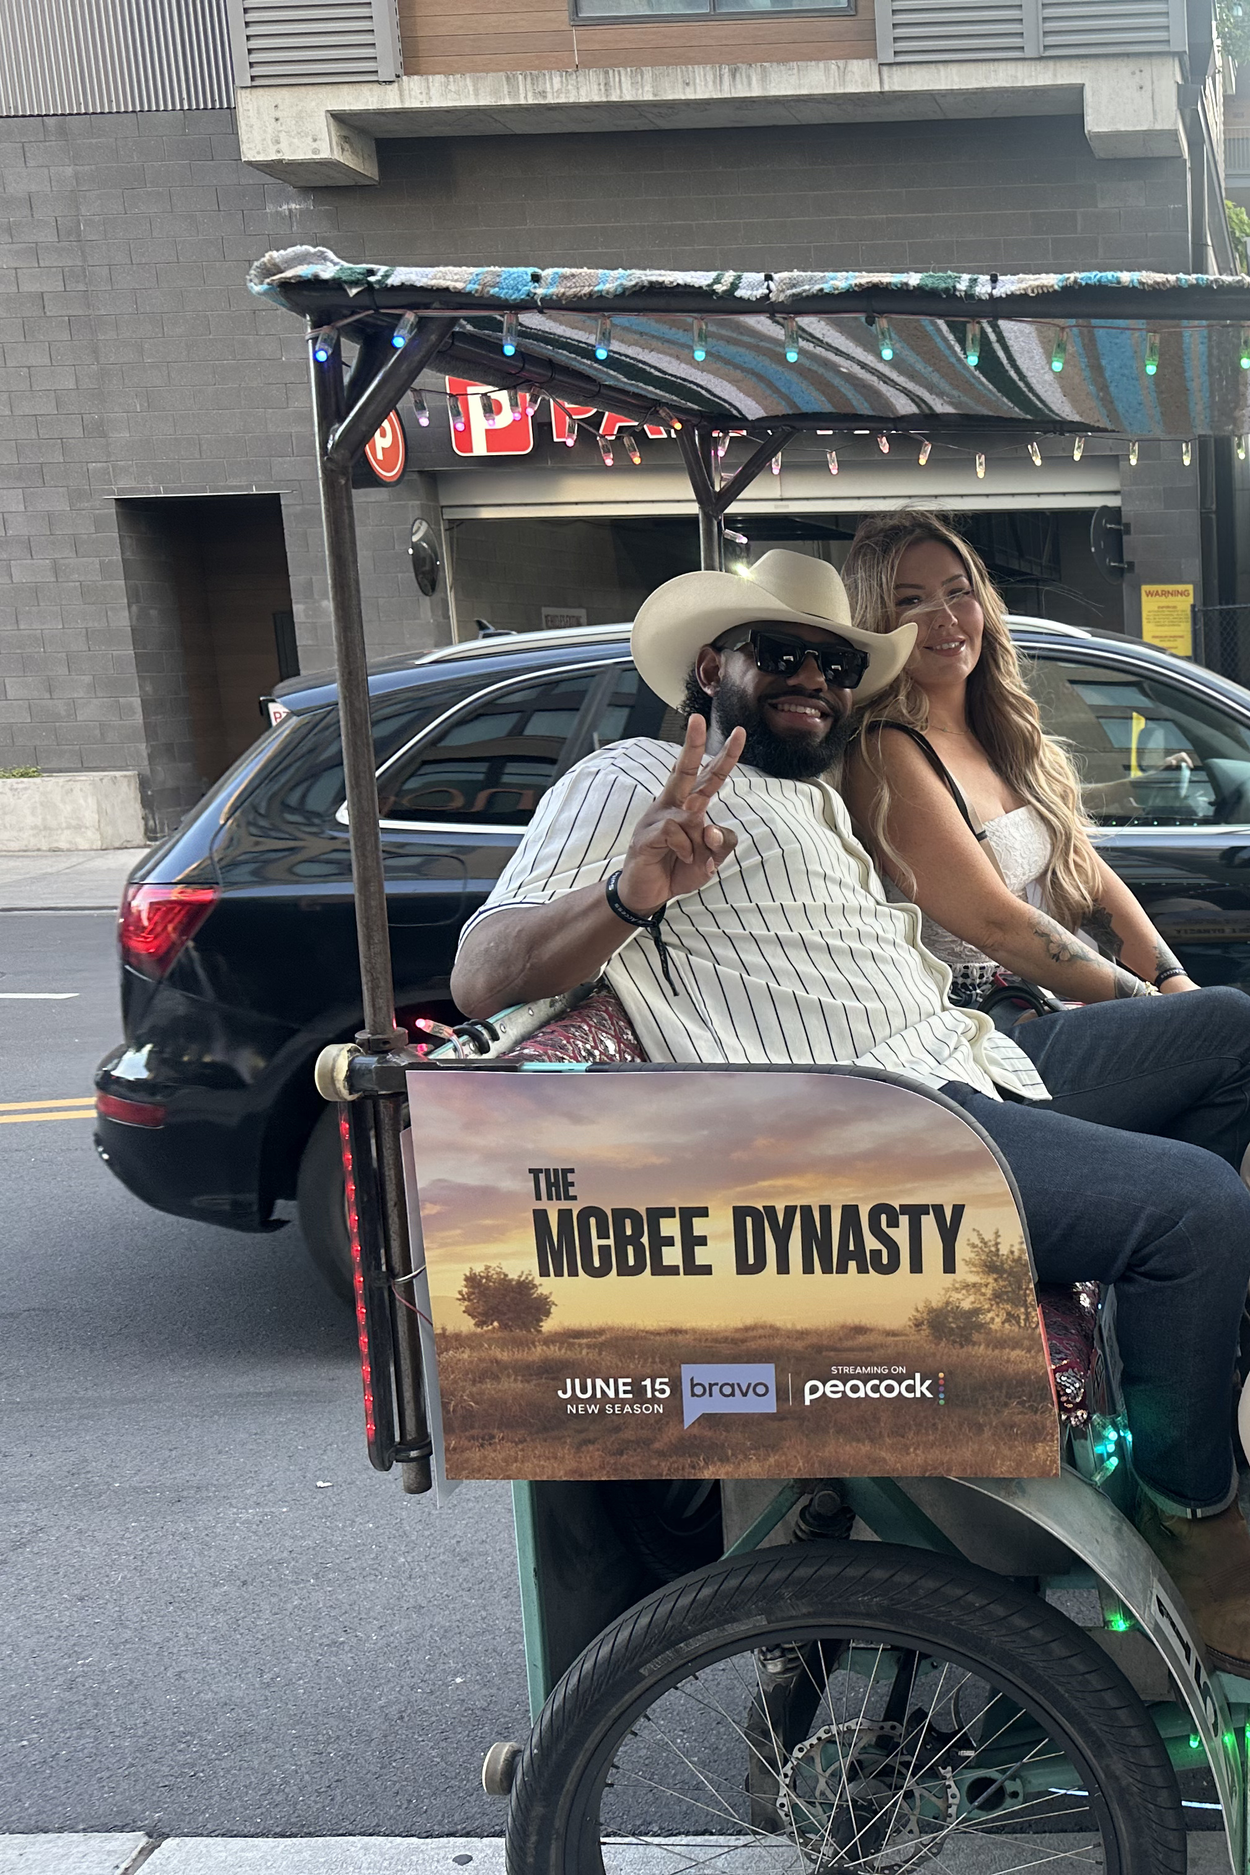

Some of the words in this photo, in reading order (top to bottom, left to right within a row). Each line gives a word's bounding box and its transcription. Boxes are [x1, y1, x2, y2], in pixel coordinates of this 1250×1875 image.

[1144, 589, 1191, 599] WARNING
[528, 1167, 578, 1201] THE
[532, 1206, 713, 1278] MCBEE
[732, 1203, 966, 1275] DYNASTY
[830, 1365, 888, 1375] STREAMING
[890, 1365, 907, 1375] ON
[557, 1377, 633, 1400] JUNE
[641, 1377, 672, 1399] 15
[689, 1375, 770, 1399] bravo
[803, 1371, 934, 1406] peacock
[566, 1403, 602, 1415] NEW
[605, 1402, 664, 1414] SEASON
